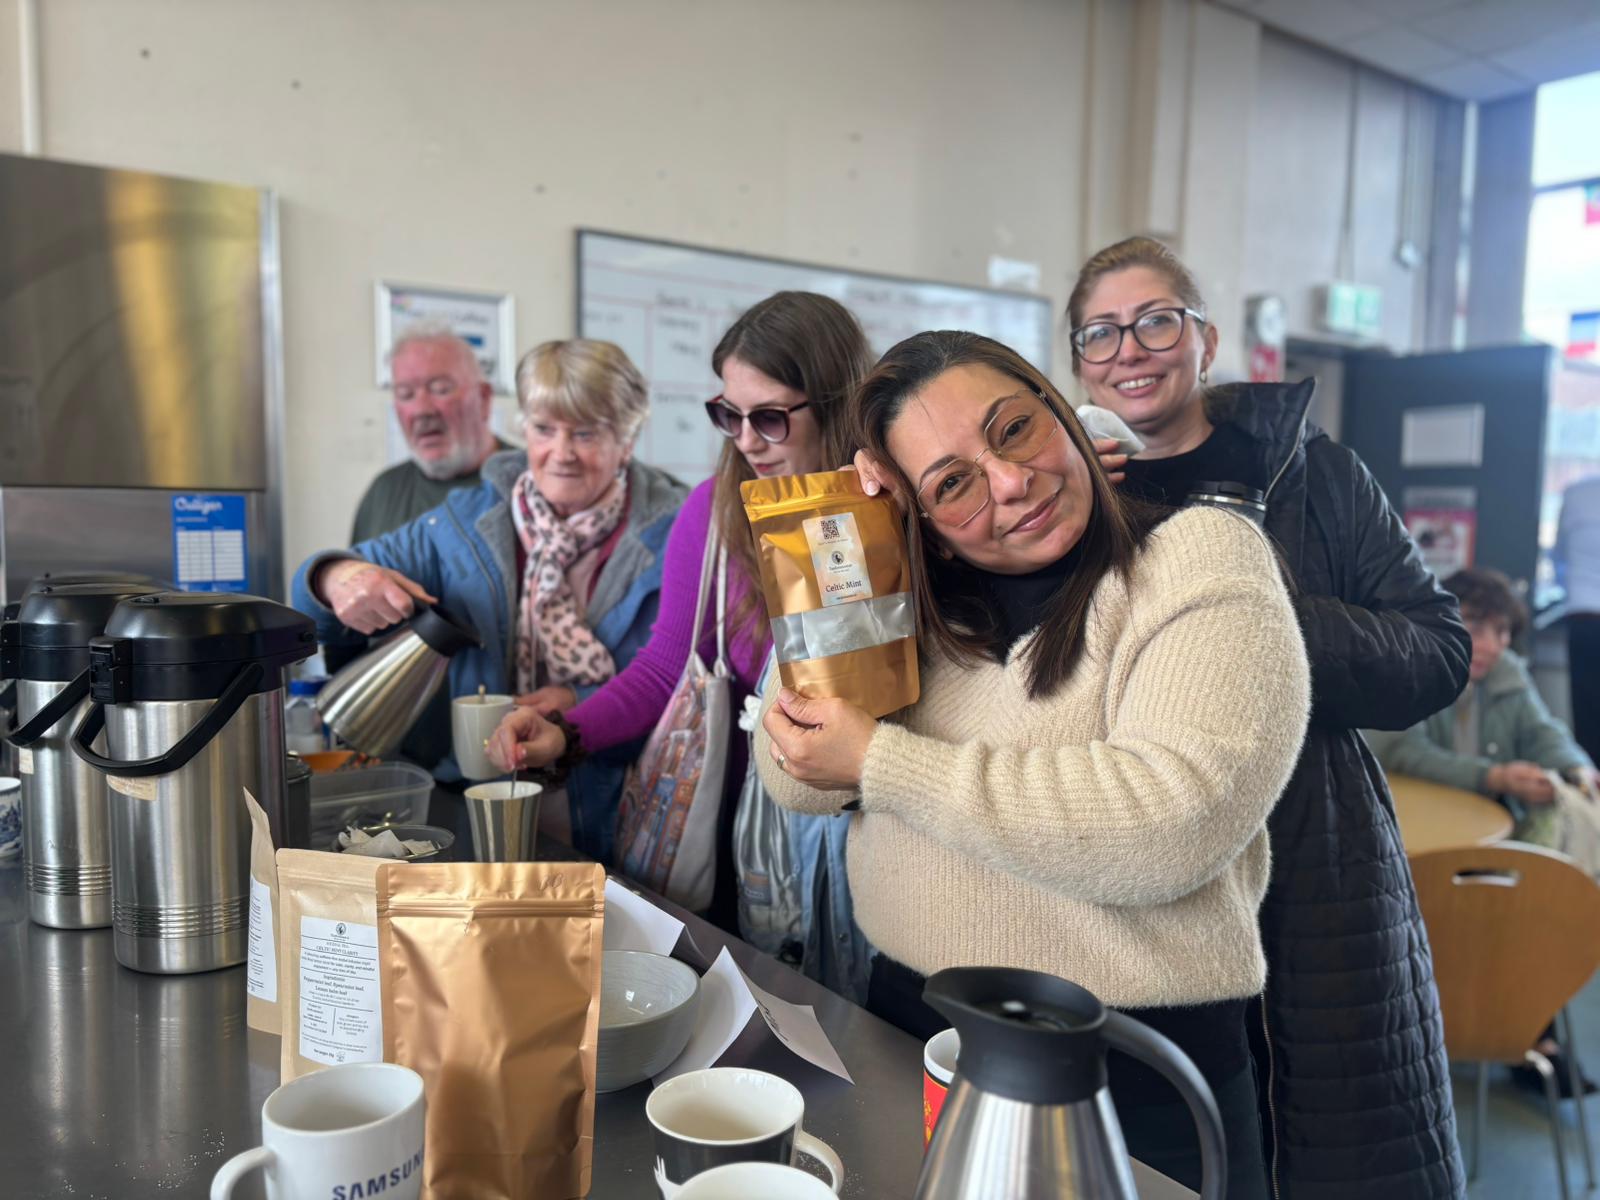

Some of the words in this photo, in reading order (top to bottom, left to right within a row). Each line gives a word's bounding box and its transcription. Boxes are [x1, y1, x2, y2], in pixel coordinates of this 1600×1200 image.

[825, 583, 845, 593] Celtic
[846, 580, 862, 589] Mint
[332, 1149, 423, 1200] SAMSUN
